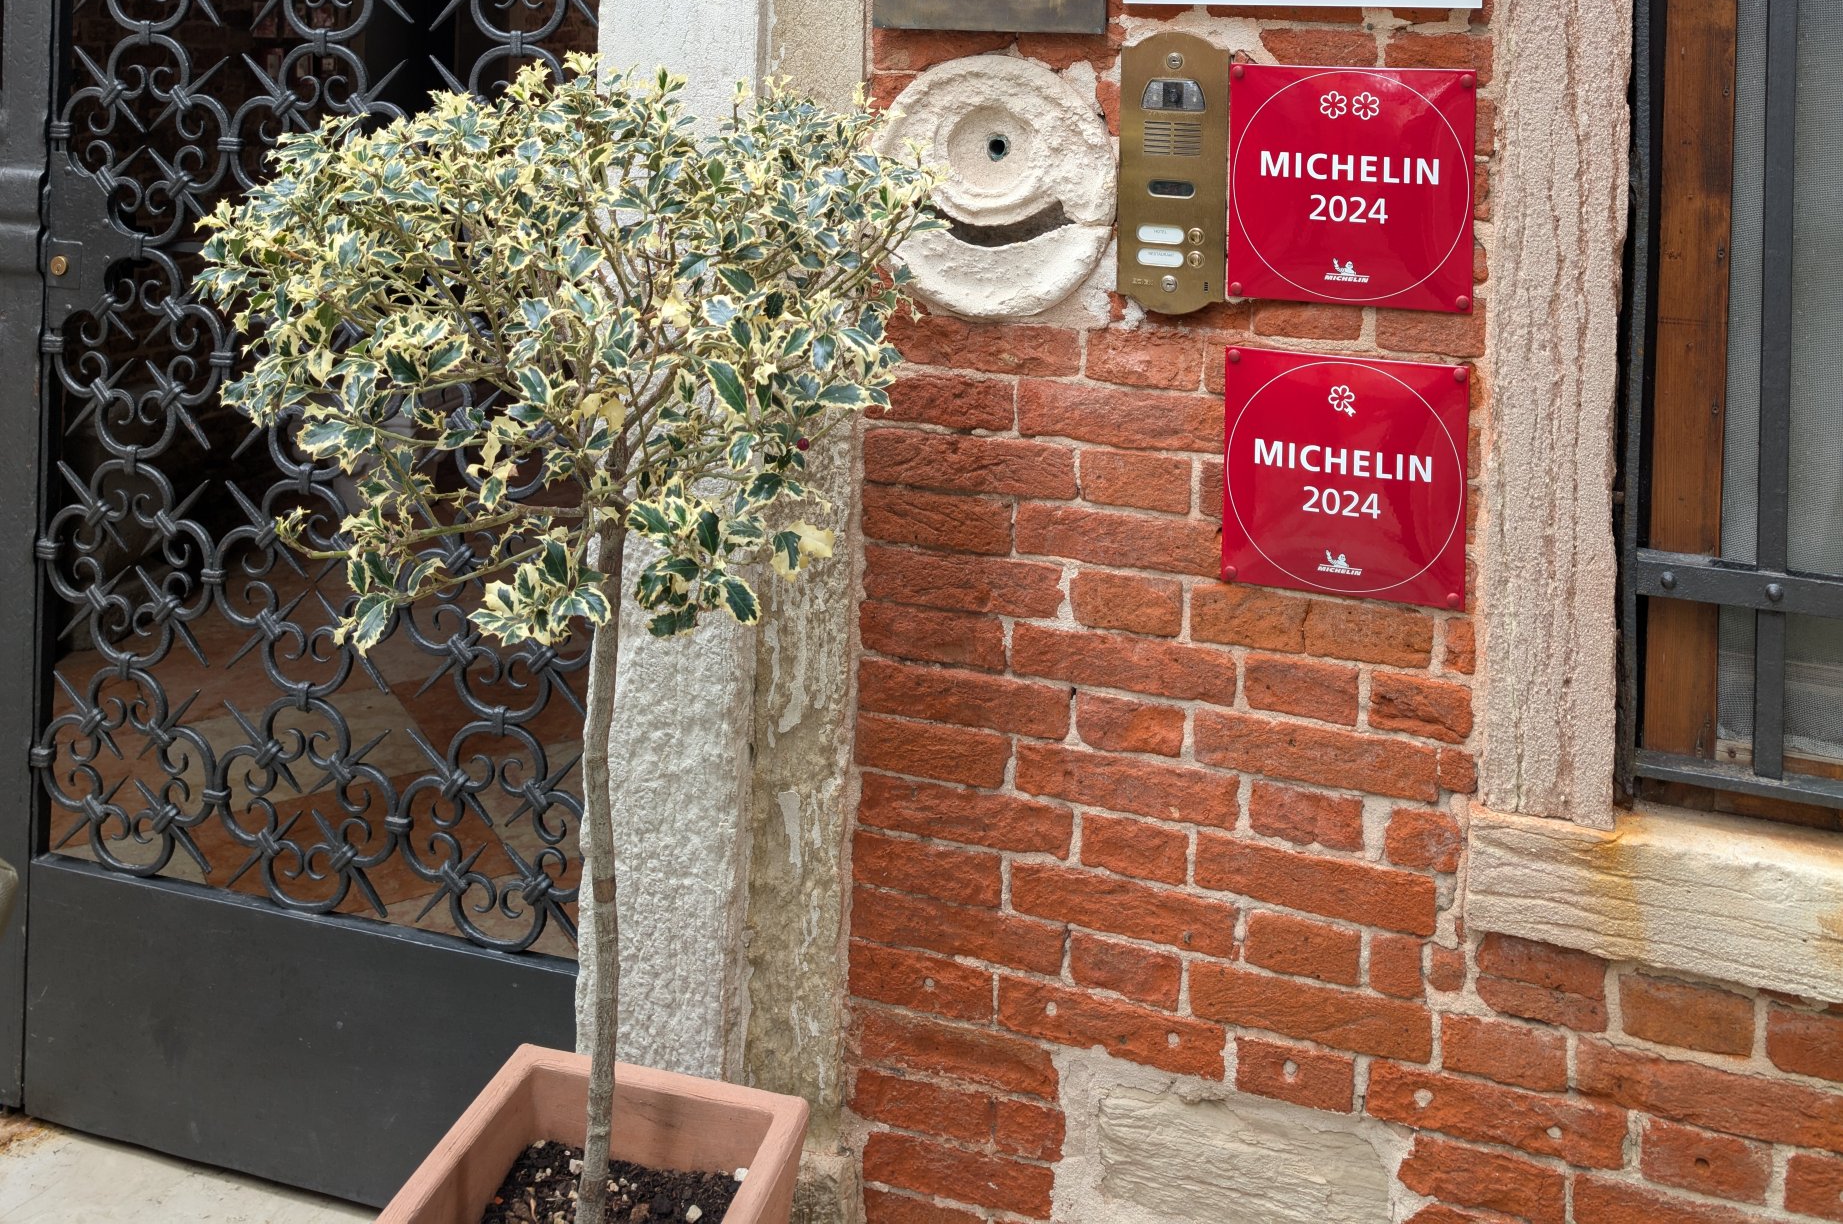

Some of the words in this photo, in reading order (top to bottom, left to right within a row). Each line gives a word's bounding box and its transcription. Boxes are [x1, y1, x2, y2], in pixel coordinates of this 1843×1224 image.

[1259, 151, 1440, 185] MICHELIN
[1308, 194, 1388, 224] 2024
[1324, 274, 1369, 283] MICHELIN
[1253, 438, 1433, 483] MICHELIN
[1302, 485, 1381, 520] 2024
[1317, 566, 1362, 576] MICHELIN
